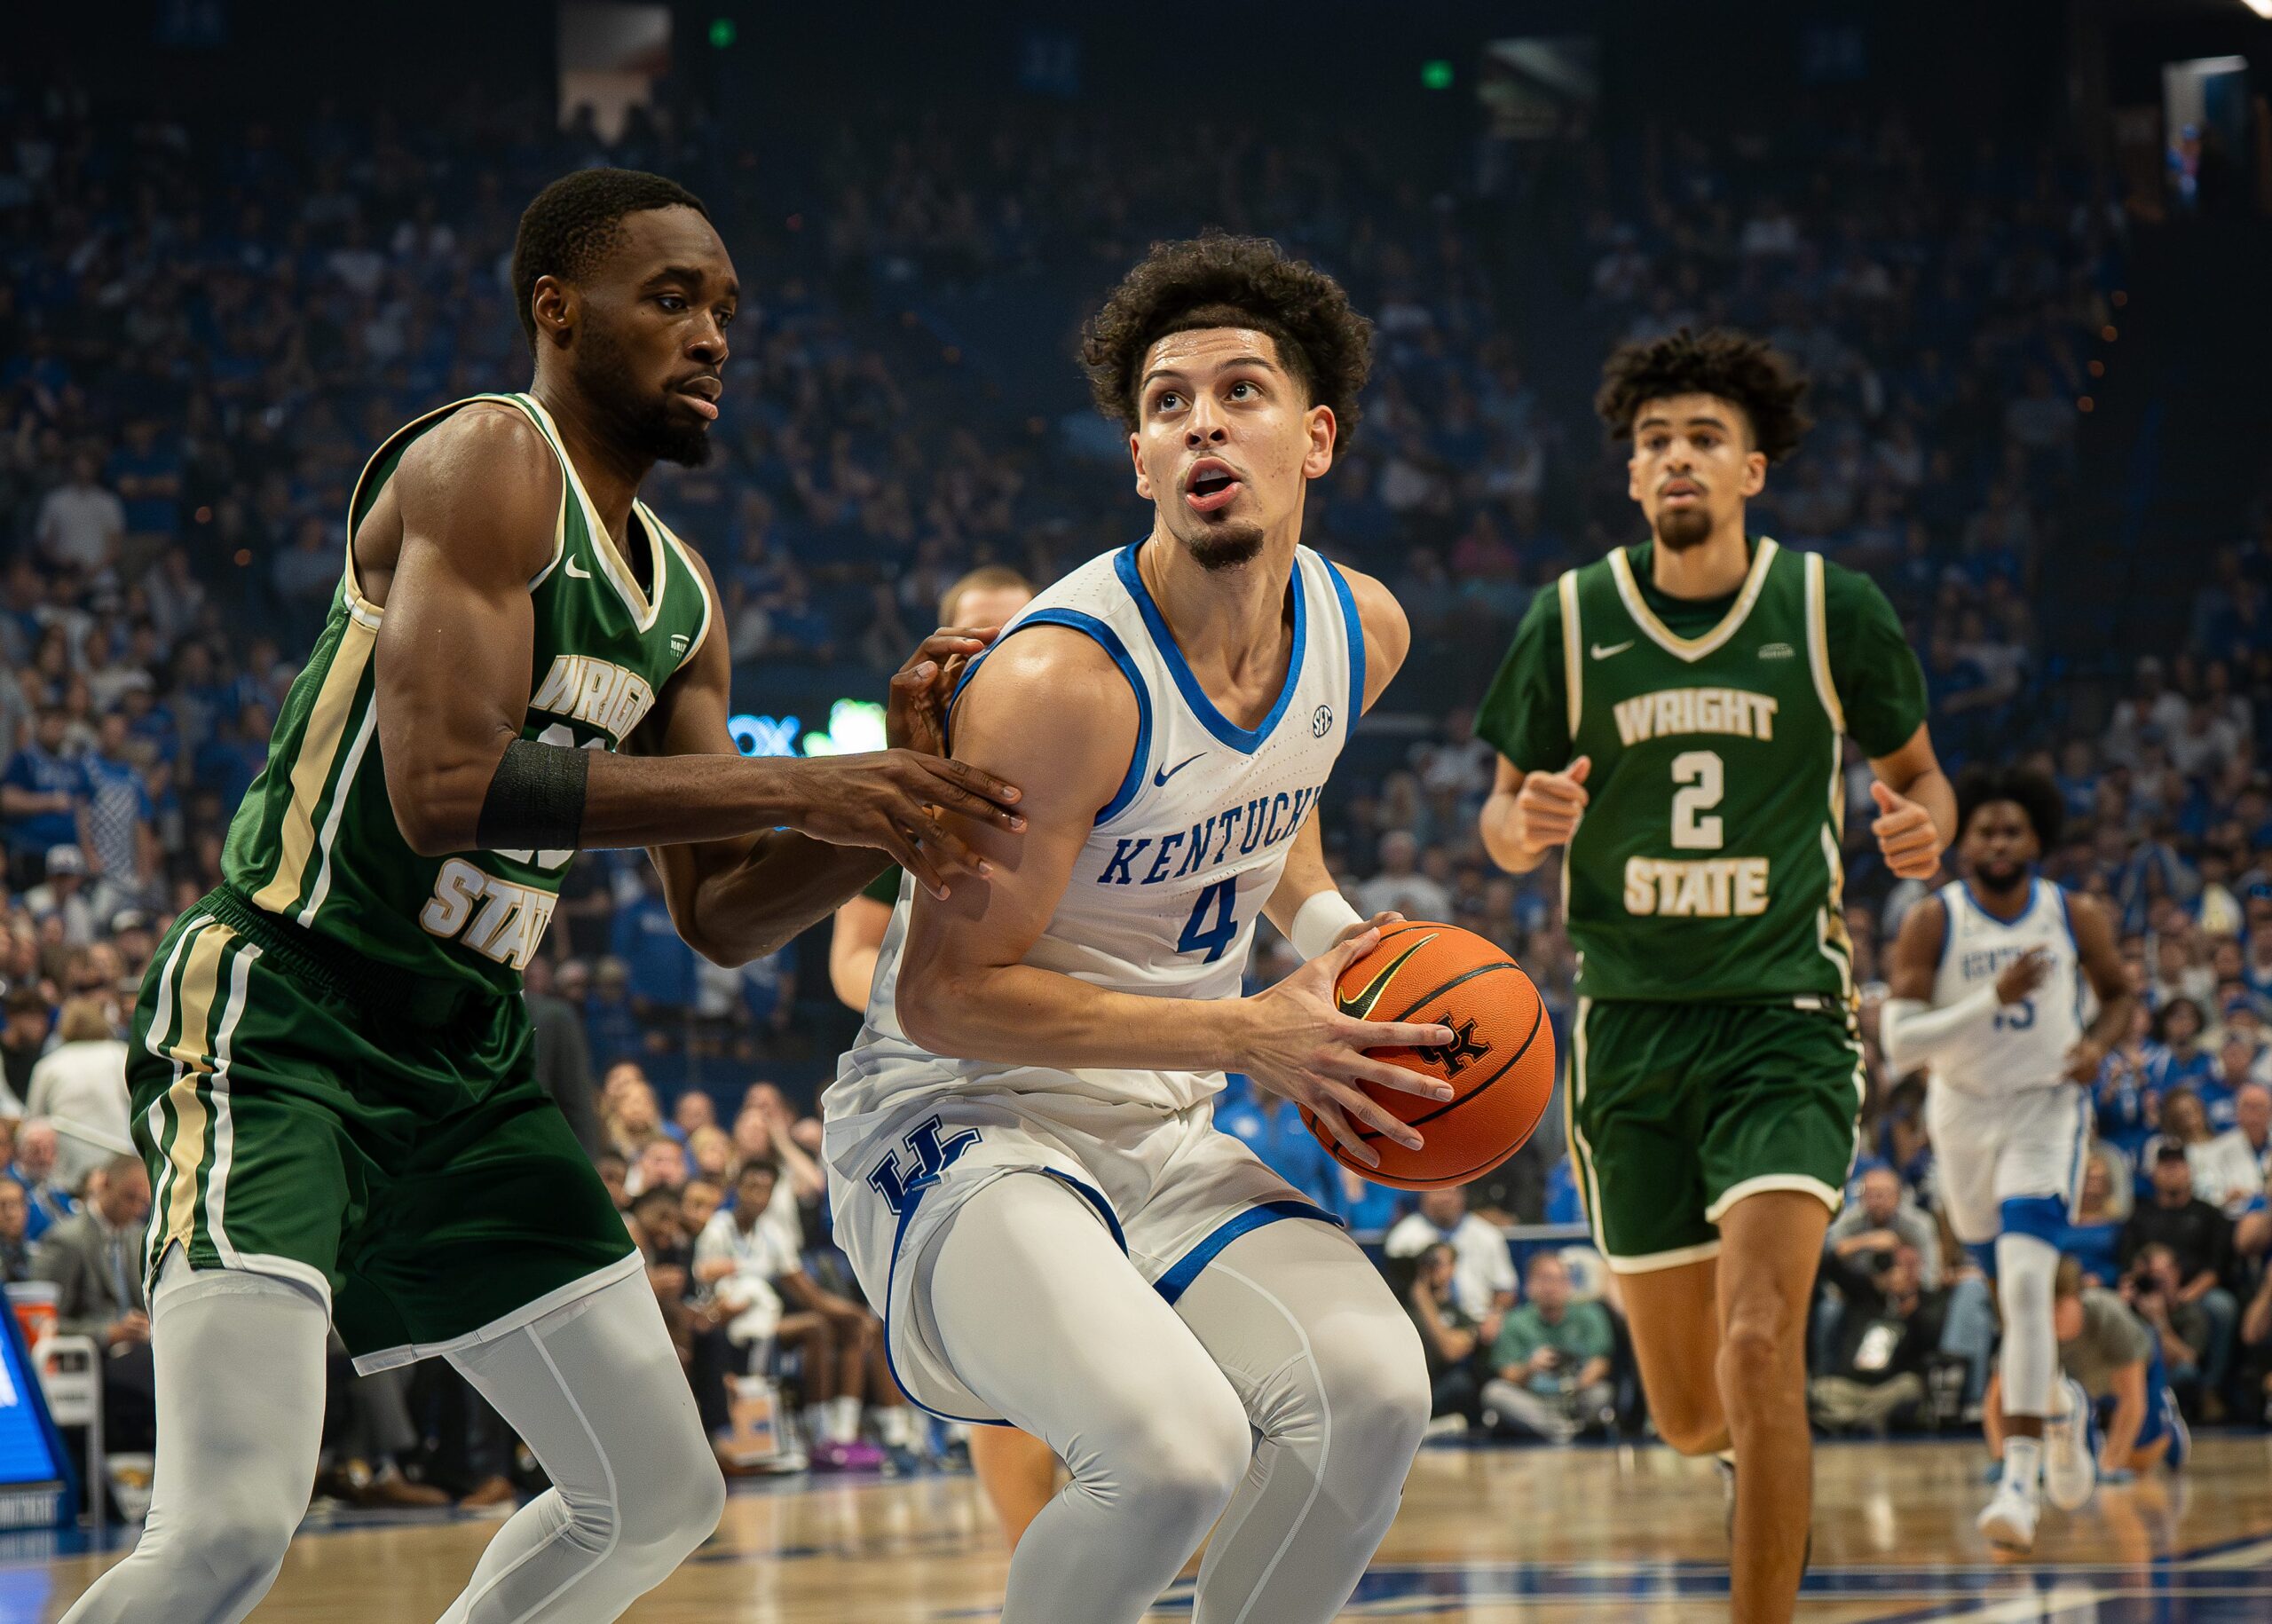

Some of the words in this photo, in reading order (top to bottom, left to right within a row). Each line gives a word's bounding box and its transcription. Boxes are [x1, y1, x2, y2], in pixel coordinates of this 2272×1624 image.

[1313, 705, 1333, 737] SEC
[1613, 687, 1779, 746] WRIGHT
[1671, 750, 1724, 849] 2
[1623, 855, 1771, 918] STATE
[1177, 874, 1238, 965] 4
